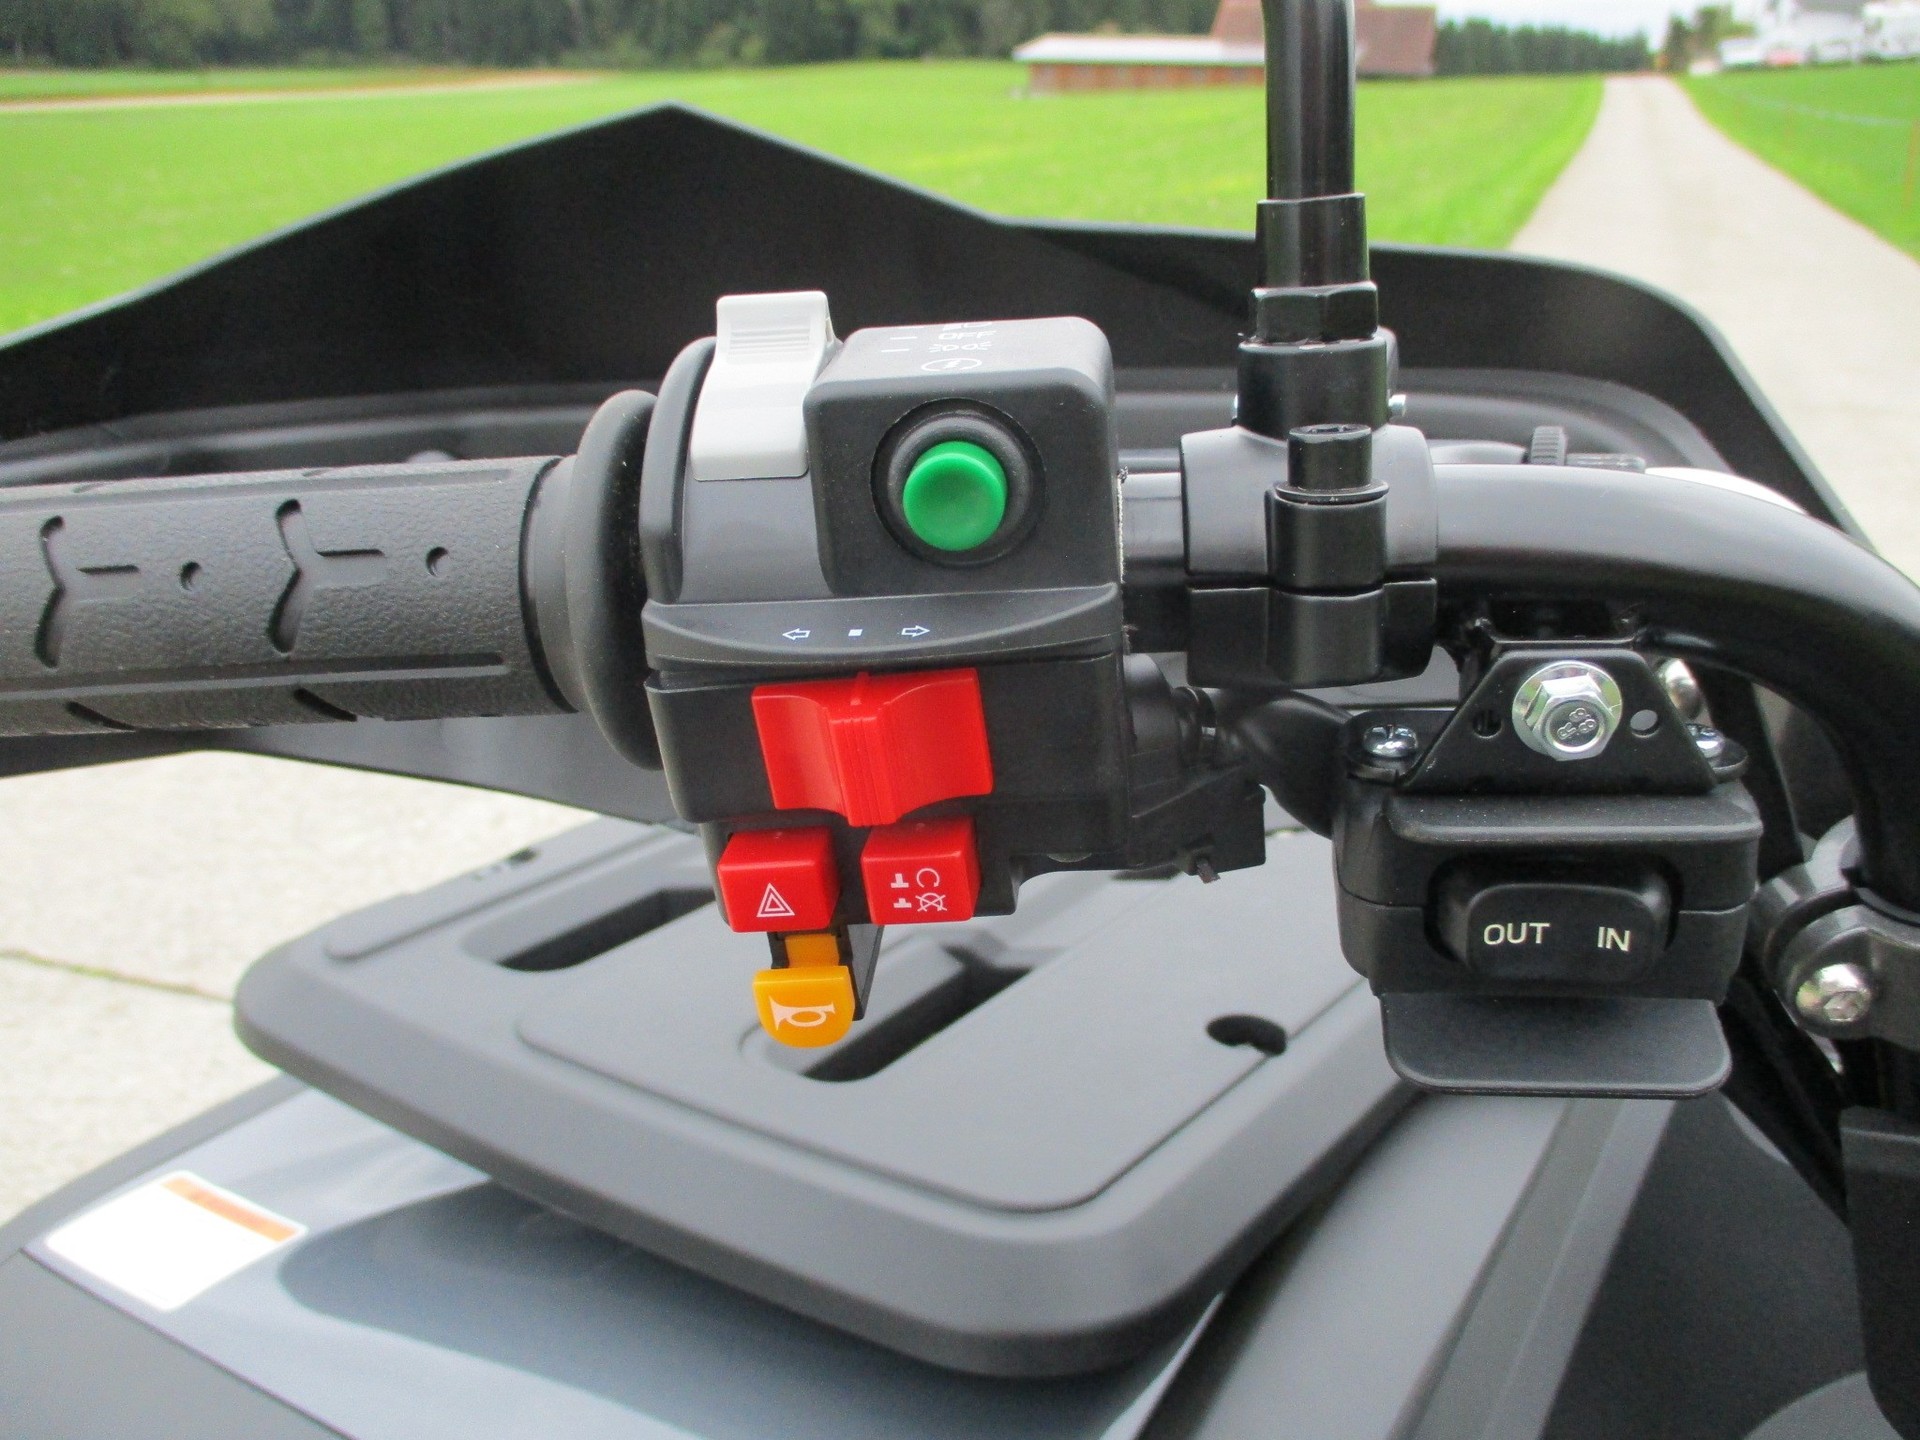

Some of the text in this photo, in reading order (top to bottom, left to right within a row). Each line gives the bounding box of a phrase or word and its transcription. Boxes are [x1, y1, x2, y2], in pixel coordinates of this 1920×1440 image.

[938, 330, 996, 340] OFF
[1483, 922, 1630, 951] OUT IN
